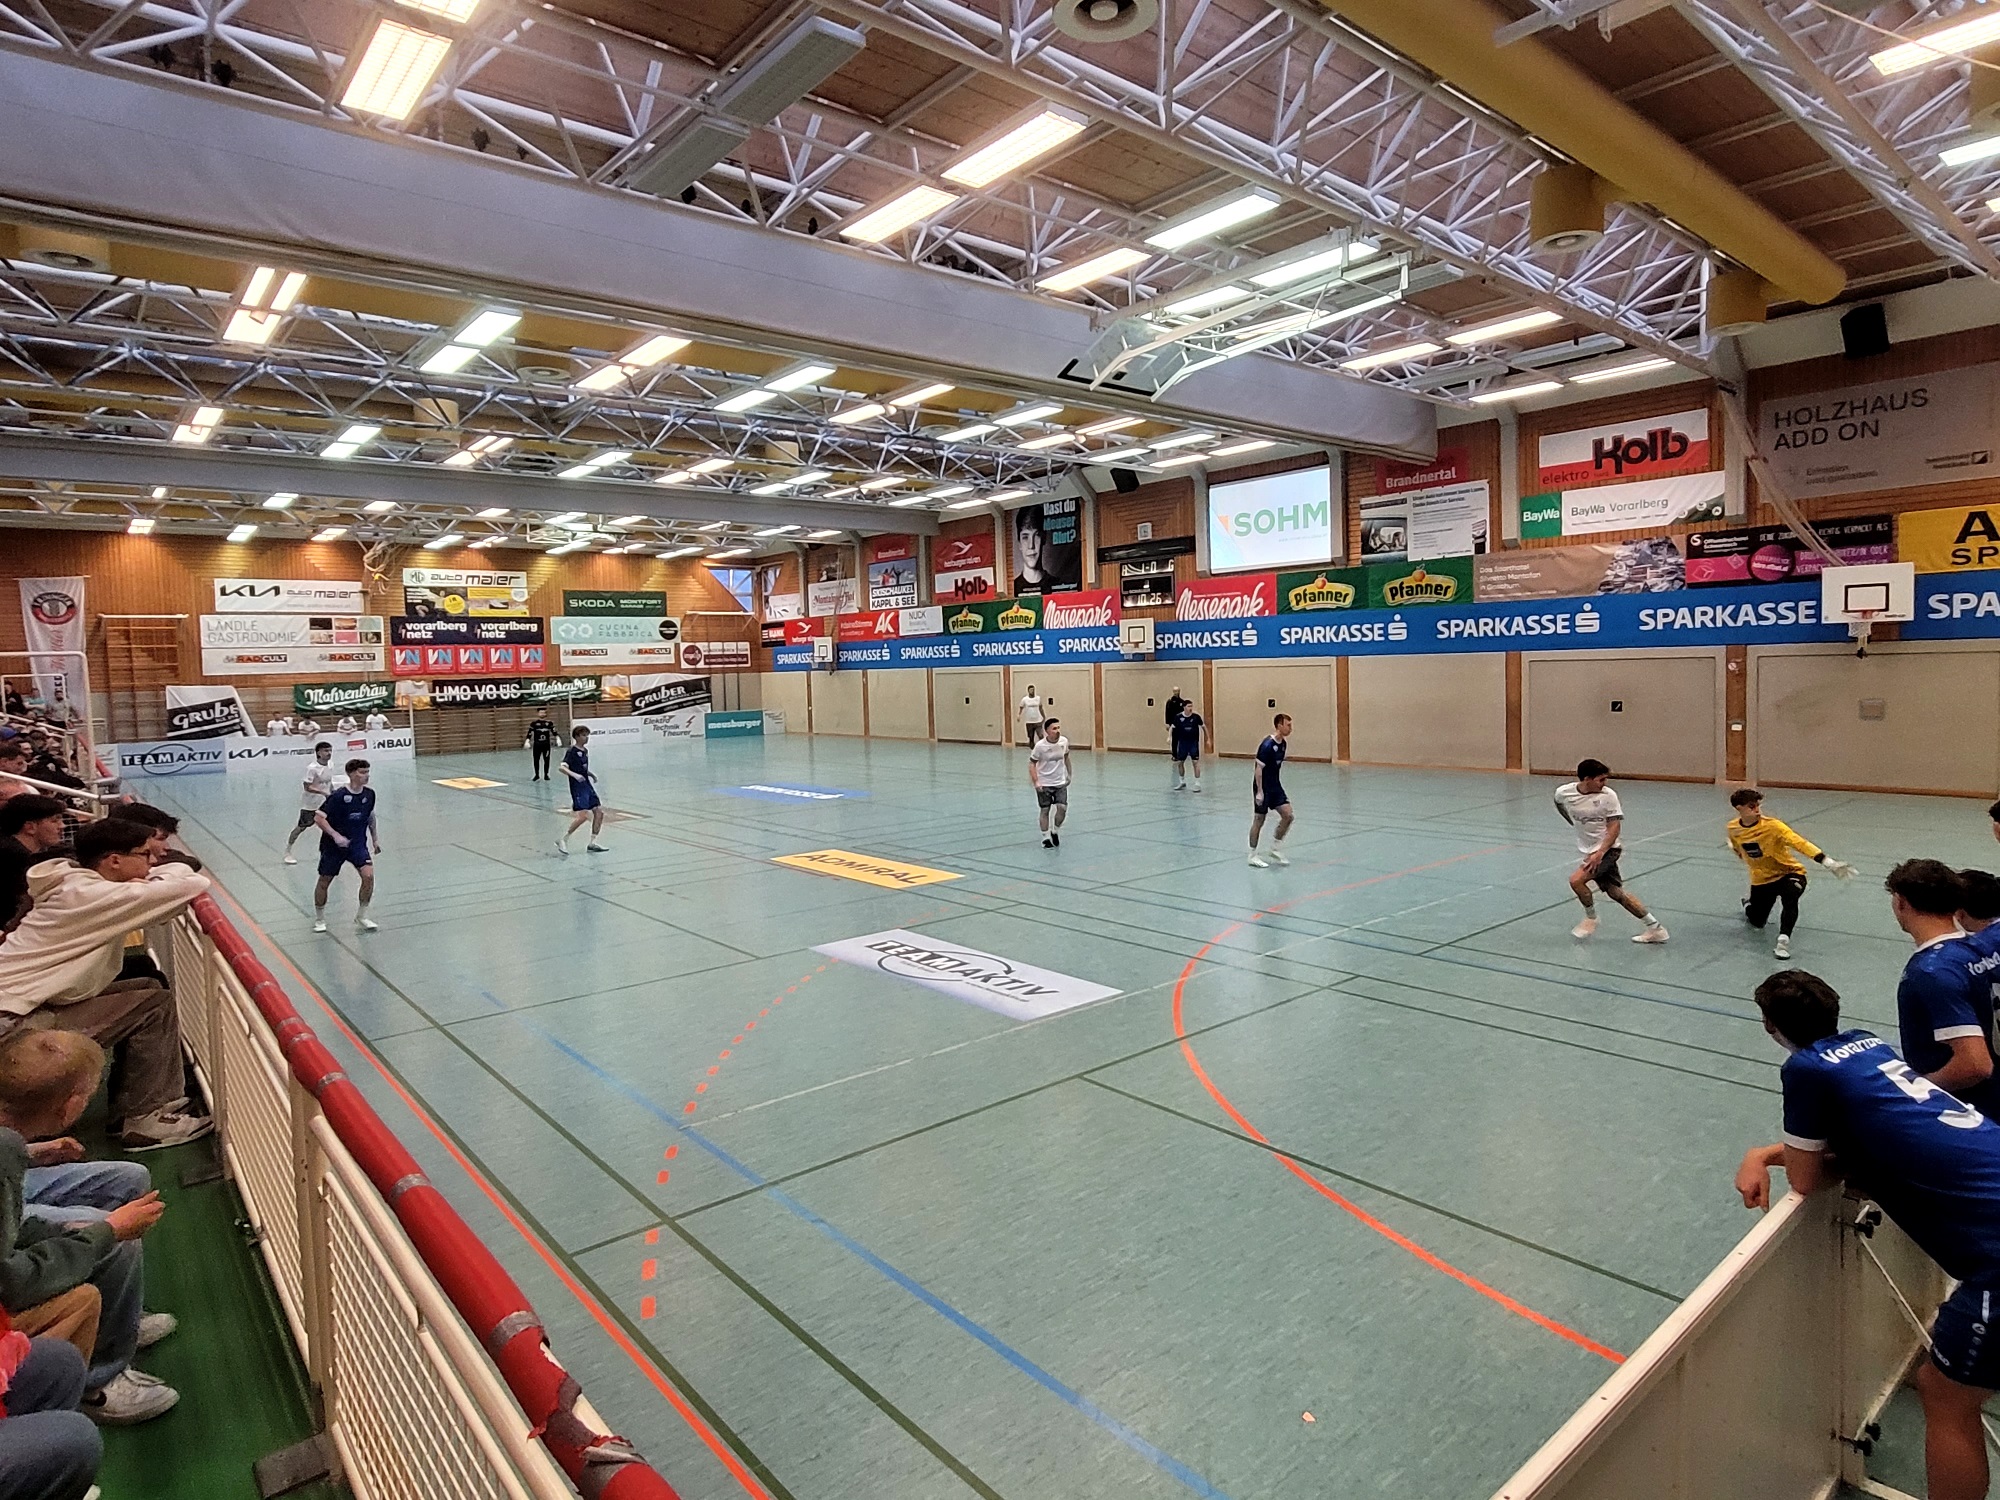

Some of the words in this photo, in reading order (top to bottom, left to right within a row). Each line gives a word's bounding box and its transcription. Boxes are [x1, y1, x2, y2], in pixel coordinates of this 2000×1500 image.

[1774, 387, 1929, 429] HOLZHAUS
[1774, 427, 1829, 451] ADD
[1838, 419, 1880, 441] ON
[1592, 426, 1689, 475] Kolb
[1385, 466, 1457, 489] Brandnertal
[1542, 469, 1590, 485] elektro
[1064, 498, 1076, 513] du
[1571, 504, 1605, 517] BayWa
[1610, 498, 1669, 513] Vorarlberg
[1234, 500, 1328, 537] SOHM
[1523, 508, 1560, 522] BayWa
[430, 573, 463, 581] auto
[465, 572, 521, 586] maier
[954, 575, 988, 600] Kolb
[871, 585, 915, 598] SKISCHAUKEL
[871, 597, 894, 609] KAPPL
[895, 597, 900, 607] &
[902, 596, 916, 606] SEE
[873, 611, 895, 635] AK
[1638, 600, 1818, 632] SPARKASSE
[207, 618, 259, 632] LÄNDLE
[405, 620, 467, 633] vorarlberg
[480, 620, 538, 633] vorarlberg
[599, 623, 640, 632] CUCINA
[1436, 613, 1571, 639] SPARKASSE
[207, 631, 298, 644] GASTRONOMIE
[406, 630, 434, 640] netz
[481, 630, 507, 640] netz
[599, 630, 653, 638] FABBRICA
[1156, 630, 1240, 650] SPARKASSE
[1279, 622, 1385, 646] SPARKASSE
[900, 645, 950, 660] SPARKASSE
[972, 640, 1032, 657] SPARKASSE
[1058, 636, 1121, 654] SPARKASS
[394, 648, 421, 665] VN
[427, 648, 452, 665] VN
[459, 648, 483, 665] VN
[490, 647, 514, 664] VN
[519, 647, 543, 664] VN
[838, 649, 882, 663] SPARKASSE
[304, 682, 388, 706] Mohrenbräu
[435, 684, 471, 702] LIMO
[474, 684, 497, 701] VO
[499, 683, 521, 700] ÜS
[608, 727, 640, 736] LOGISTICS
[708, 719, 762, 730] meusburger
[793, 853, 928, 885] ADMIRAL
[1876, 1058, 1986, 1130] 5
